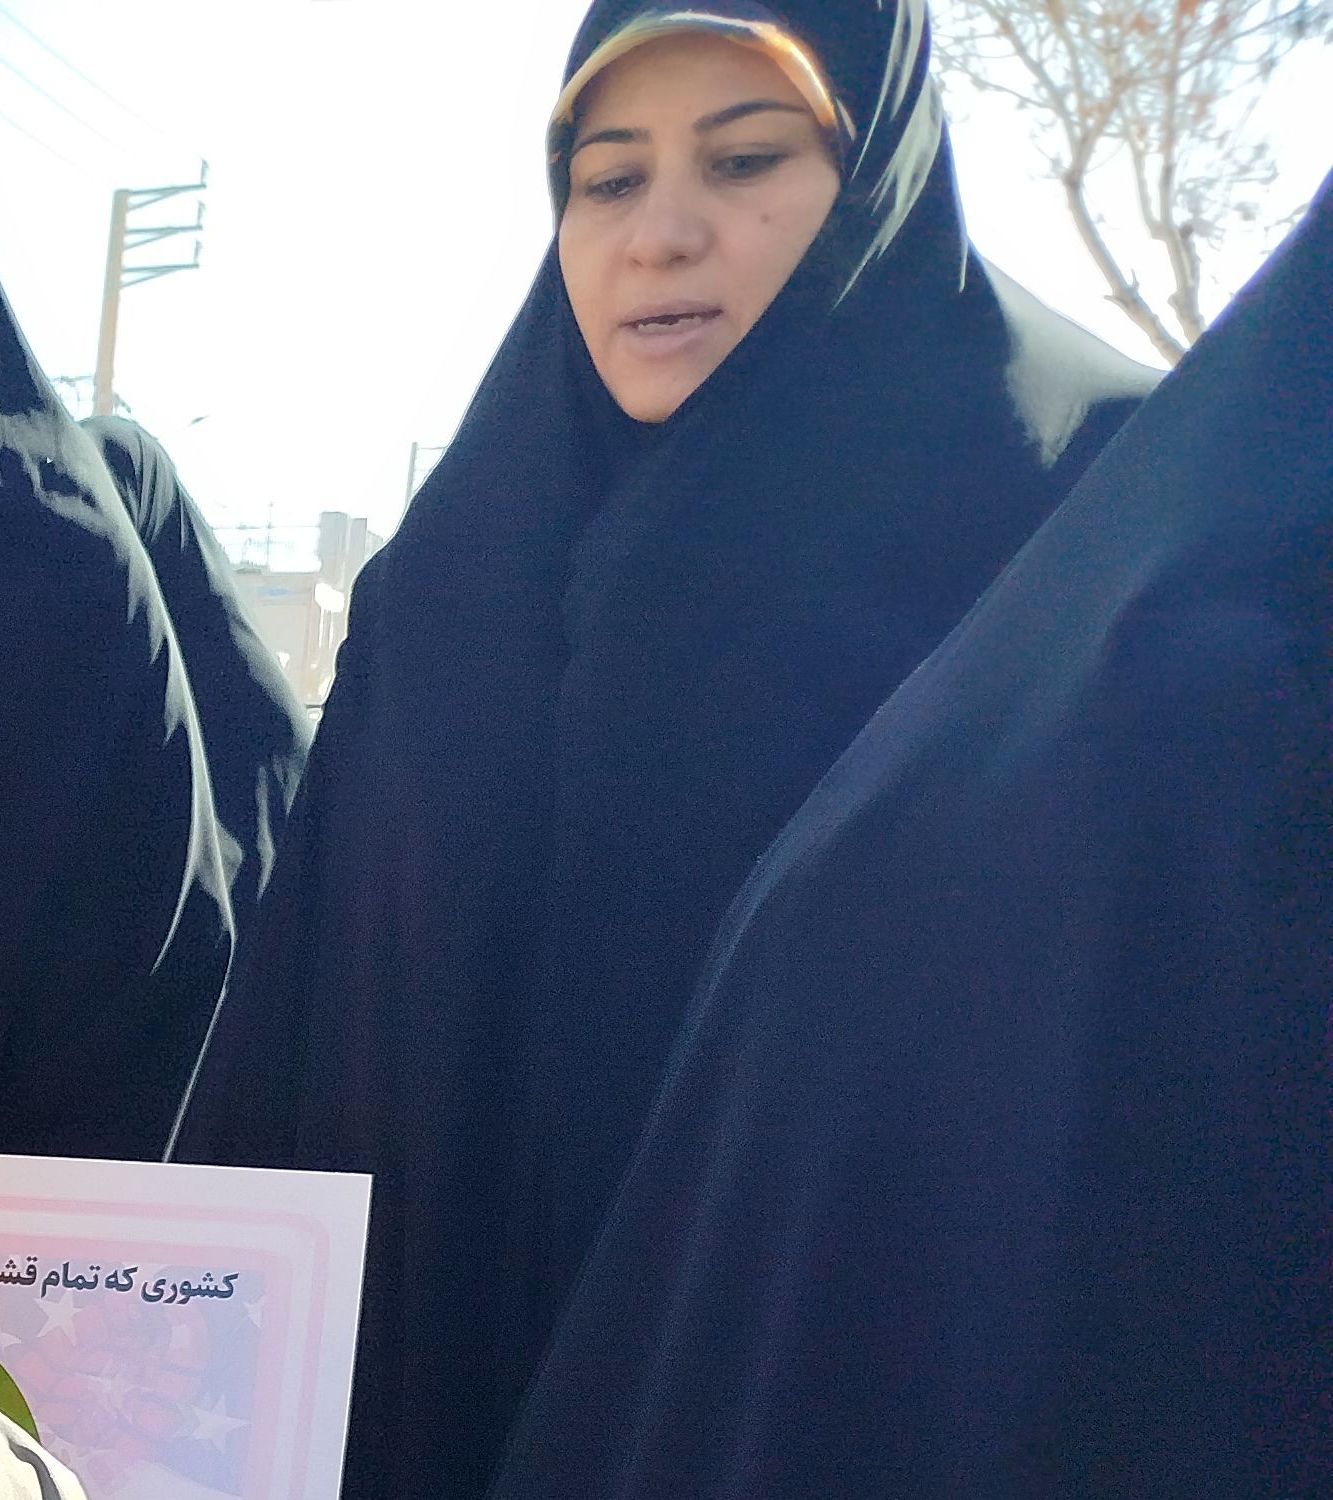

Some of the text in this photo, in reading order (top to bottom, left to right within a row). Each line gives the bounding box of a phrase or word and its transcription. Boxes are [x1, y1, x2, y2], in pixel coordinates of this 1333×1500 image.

[40, 1261, 102, 1299] تمام
[104, 1266, 138, 1294] که
[140, 1272, 239, 1305] کشوری
